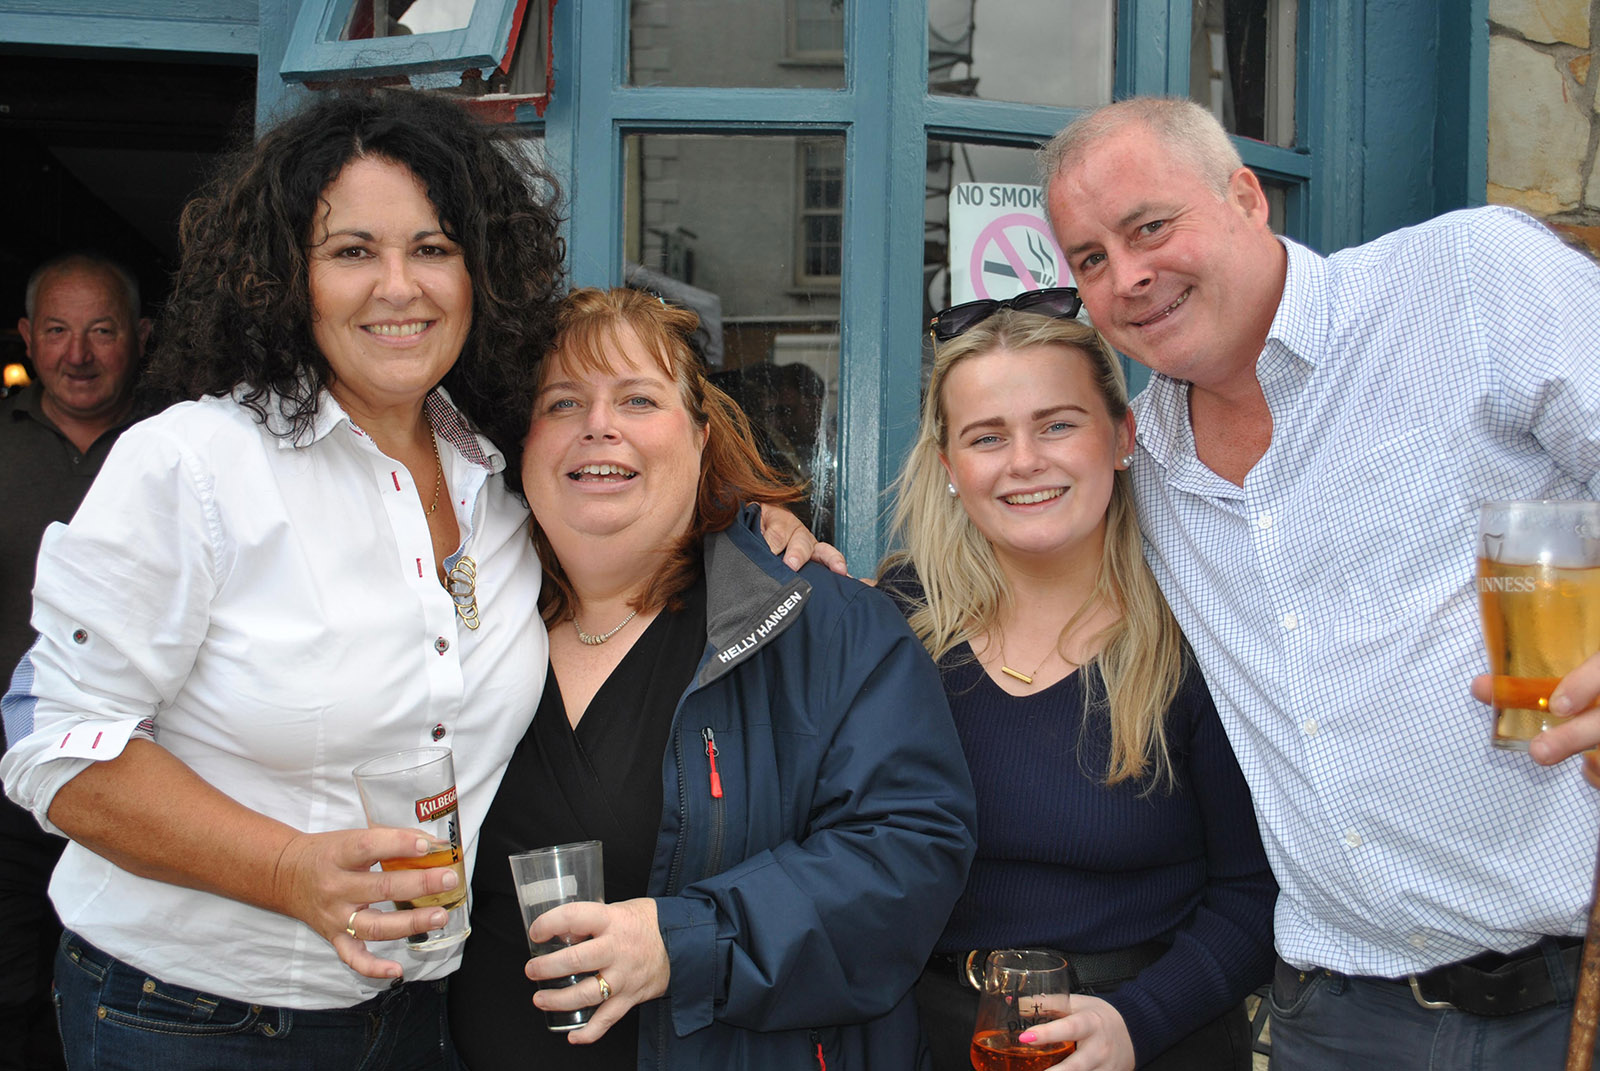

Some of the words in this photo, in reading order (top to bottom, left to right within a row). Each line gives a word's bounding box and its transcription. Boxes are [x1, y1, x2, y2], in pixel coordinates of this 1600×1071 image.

[956, 184, 984, 206] NO
[718, 632, 758, 663] HELLY
[756, 591, 803, 638] HANSEN
